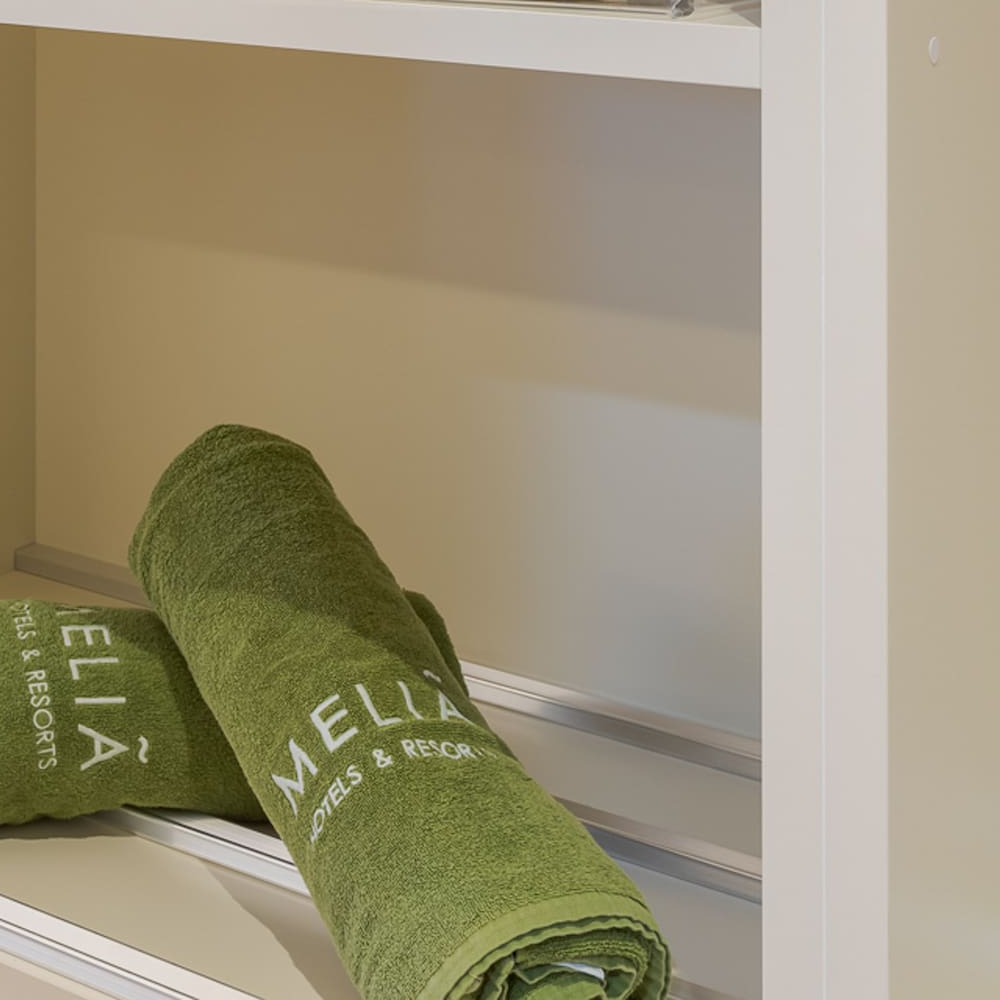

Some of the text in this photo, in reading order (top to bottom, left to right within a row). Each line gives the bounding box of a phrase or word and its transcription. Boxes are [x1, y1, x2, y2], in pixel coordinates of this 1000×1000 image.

[22, 649, 40, 662] &
[25, 669, 57, 770] RESORTS
[372, 748, 393, 769] &
